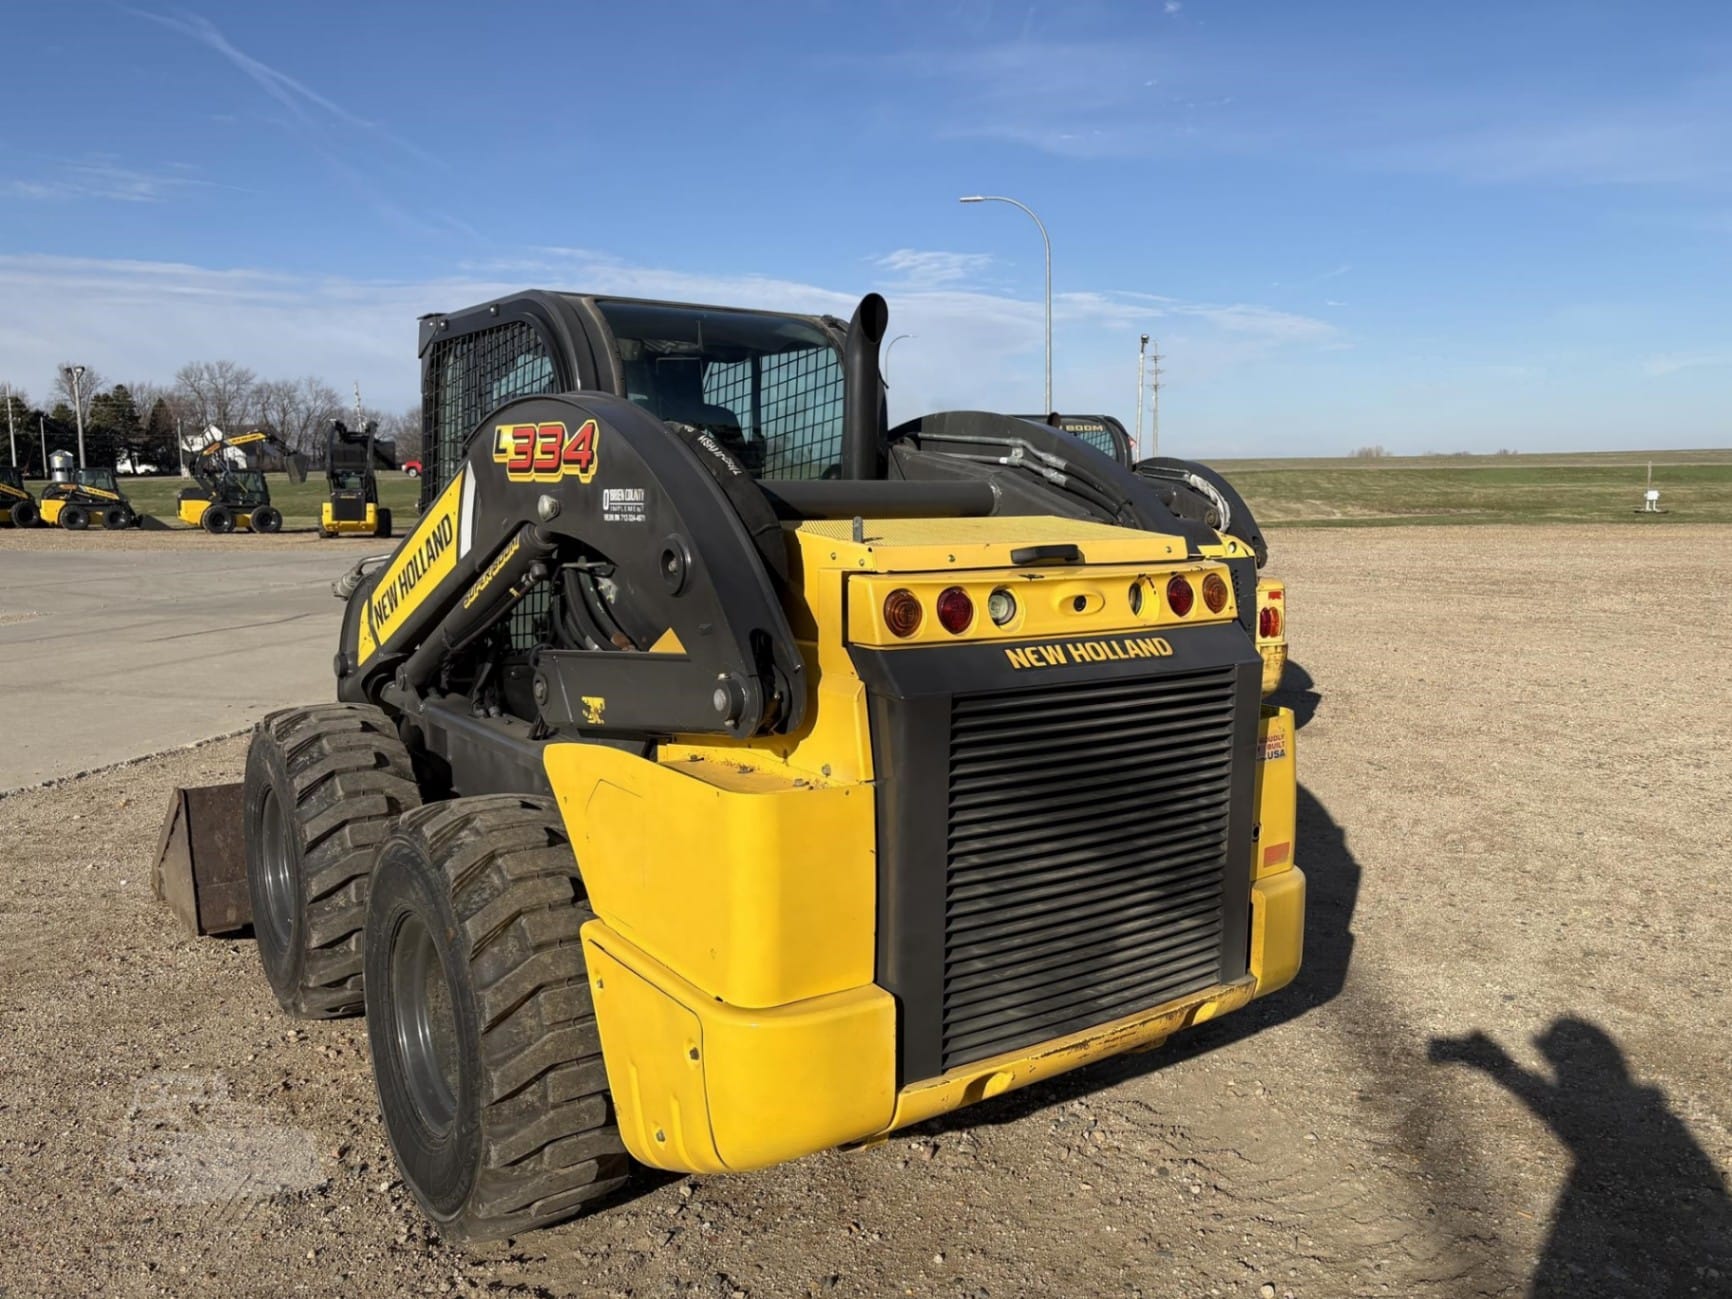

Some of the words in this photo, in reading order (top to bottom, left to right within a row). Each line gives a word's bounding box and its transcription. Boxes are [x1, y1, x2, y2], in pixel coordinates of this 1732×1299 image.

[493, 420, 599, 483] L334
[374, 580, 399, 630] NEW
[398, 513, 453, 600] HOLLAND
[1004, 644, 1068, 669] NEW
[1066, 637, 1174, 662] HOLLAND
[1267, 749, 1286, 760] USA
